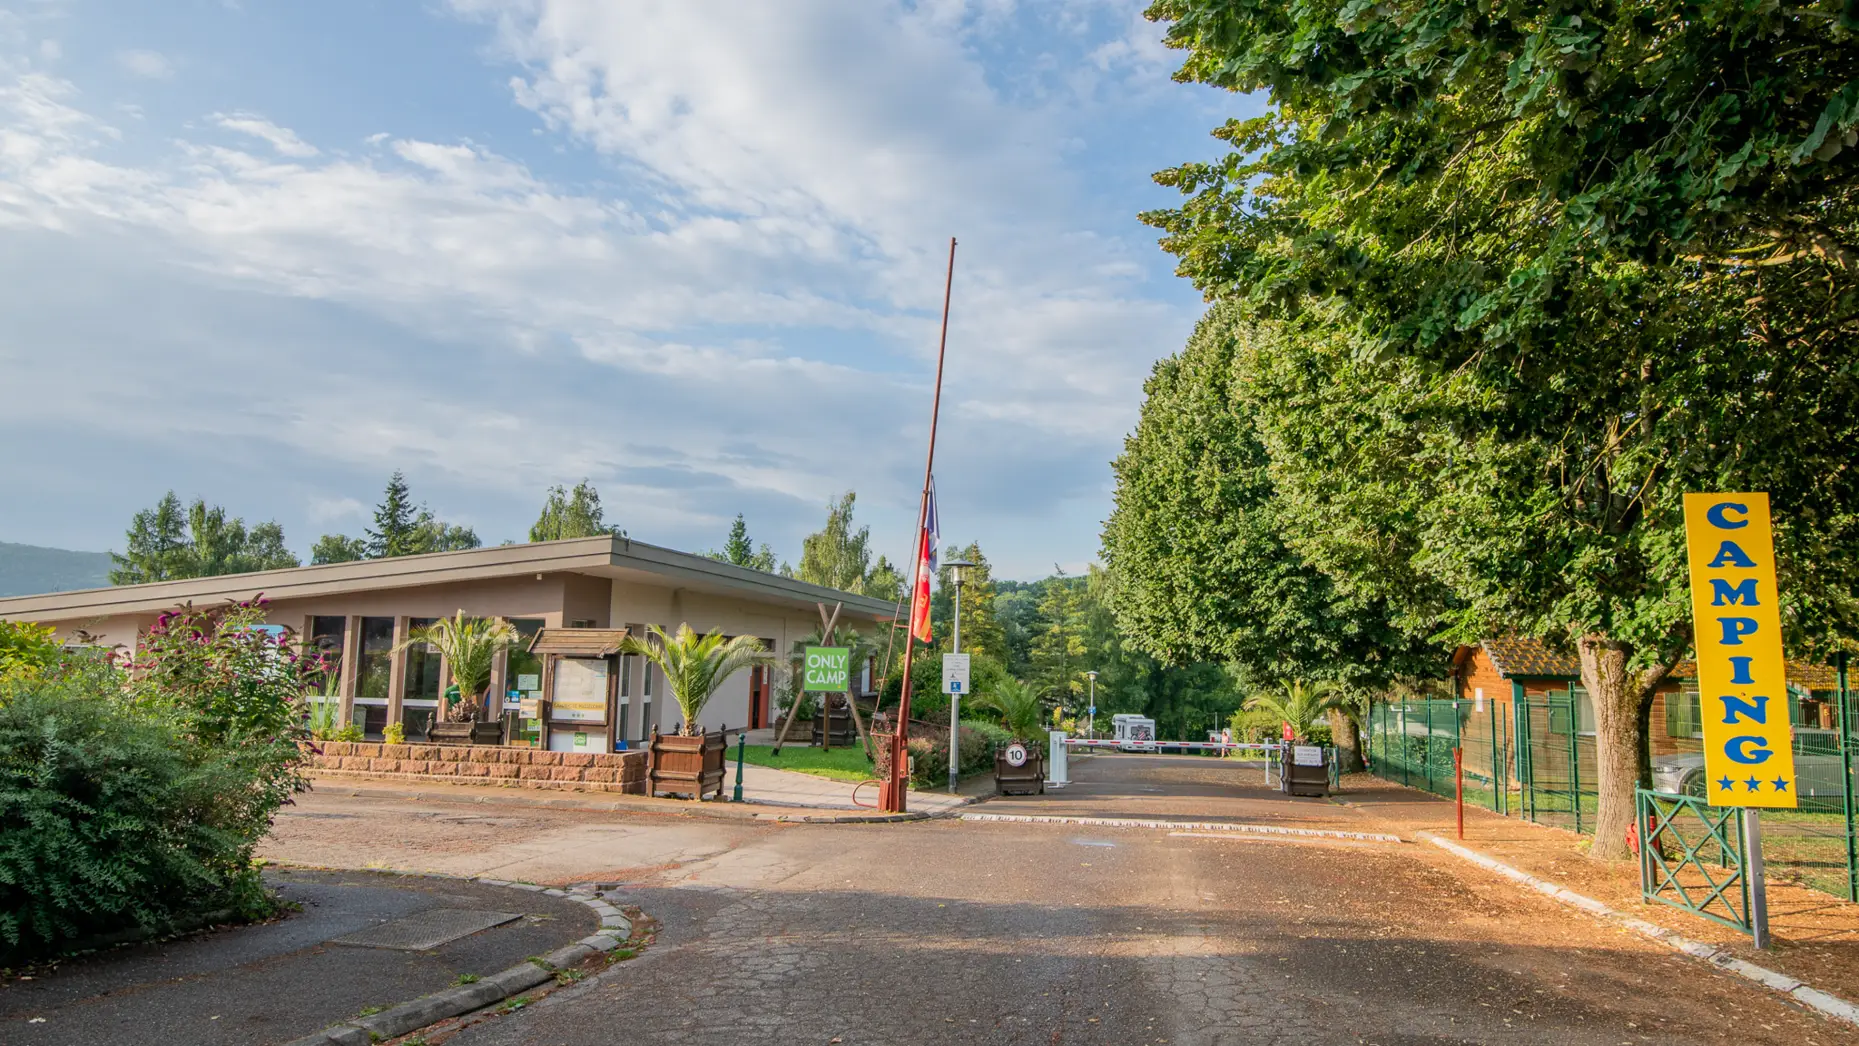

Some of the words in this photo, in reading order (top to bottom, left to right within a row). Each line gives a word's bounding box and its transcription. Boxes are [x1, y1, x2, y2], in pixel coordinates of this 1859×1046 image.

[1706, 502, 1774, 765] CAMPING
[807, 654, 846, 669] ONLY
[806, 669, 847, 685] CAMP
[1009, 750, 1023, 761] 10
